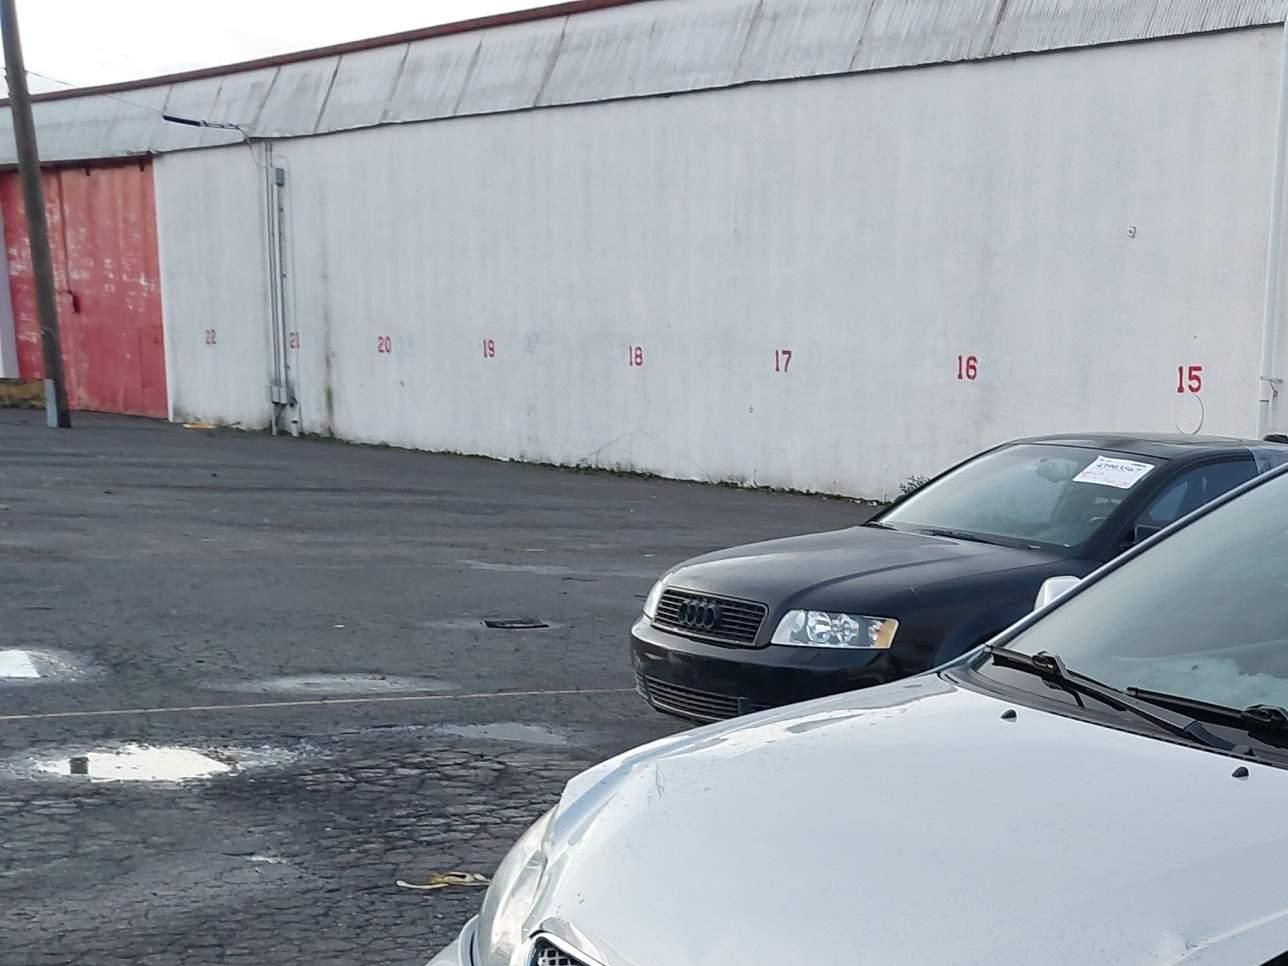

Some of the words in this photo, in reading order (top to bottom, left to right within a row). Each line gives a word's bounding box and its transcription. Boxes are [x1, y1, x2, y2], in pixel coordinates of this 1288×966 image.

[377, 335, 392, 354] 20
[482, 338, 496, 359] 19
[629, 345, 644, 367] 18
[775, 349, 793, 373] 17
[956, 354, 978, 381] 16
[1176, 365, 1203, 394] 15
